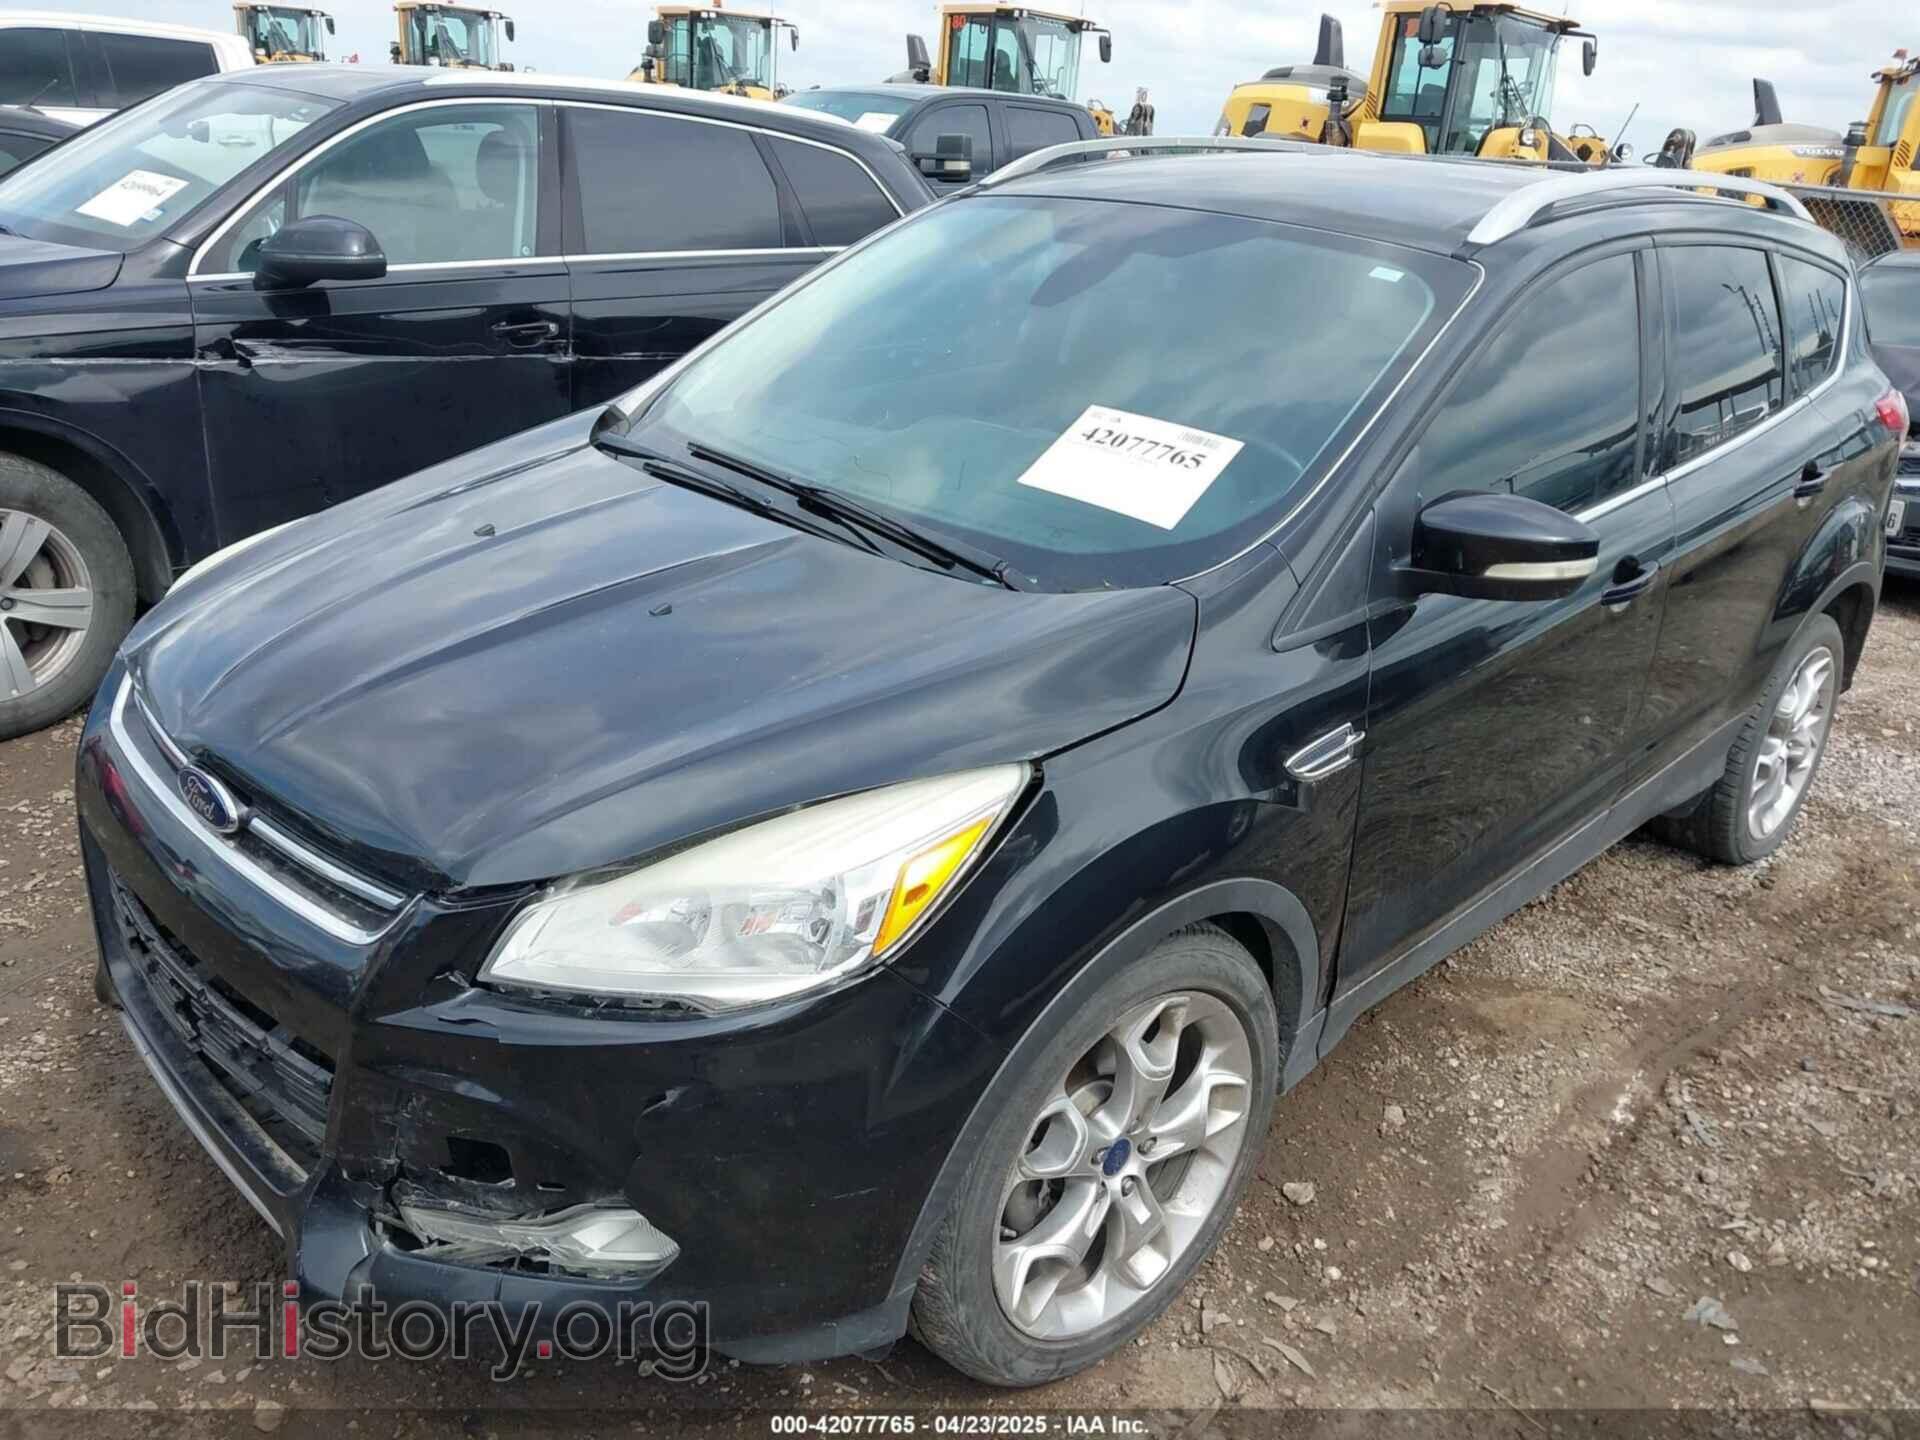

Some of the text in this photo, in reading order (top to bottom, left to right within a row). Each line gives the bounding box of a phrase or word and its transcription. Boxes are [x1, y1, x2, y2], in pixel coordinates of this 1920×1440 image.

[1795, 146, 1845, 157] VOLVO
[1082, 427, 1207, 470] 42077765
[184, 776, 215, 821] Ford
